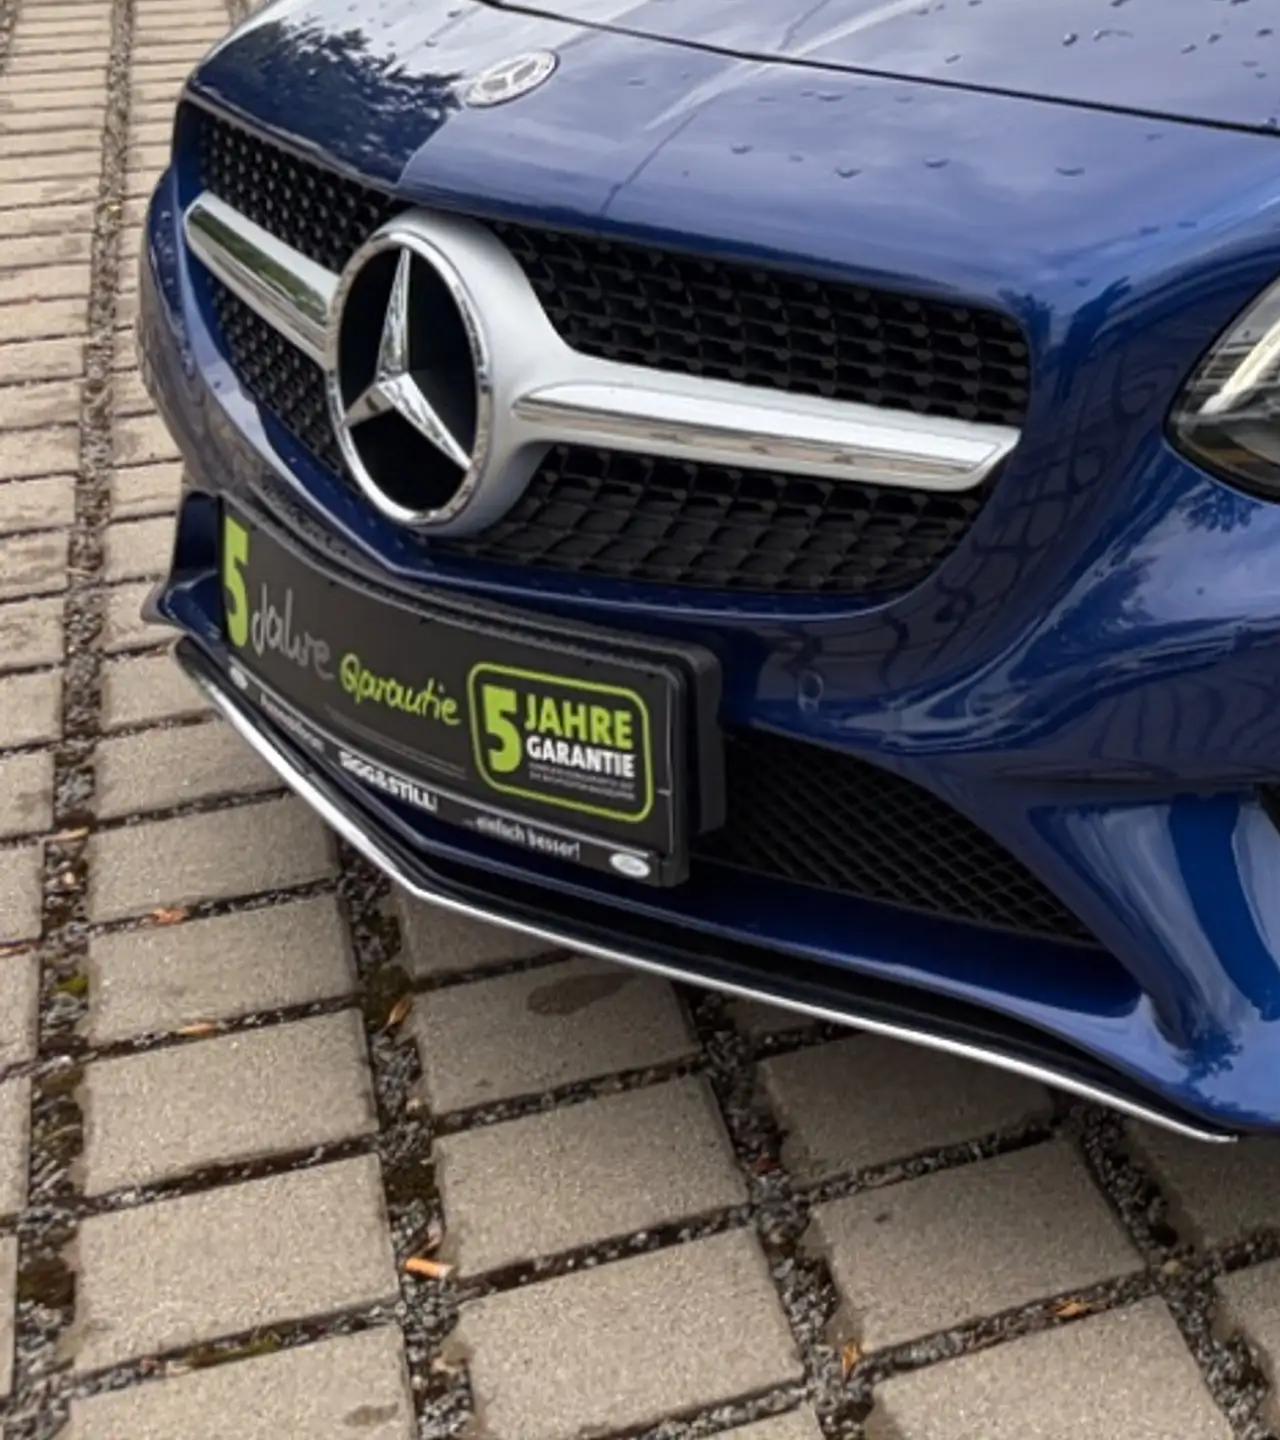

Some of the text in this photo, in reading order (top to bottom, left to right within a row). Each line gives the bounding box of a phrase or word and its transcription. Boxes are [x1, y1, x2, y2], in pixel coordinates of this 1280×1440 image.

[225, 515, 248, 648] 5
[481, 683, 523, 773] 5
[524, 693, 634, 750] JAHRE
[525, 734, 637, 778] GARANTIE
